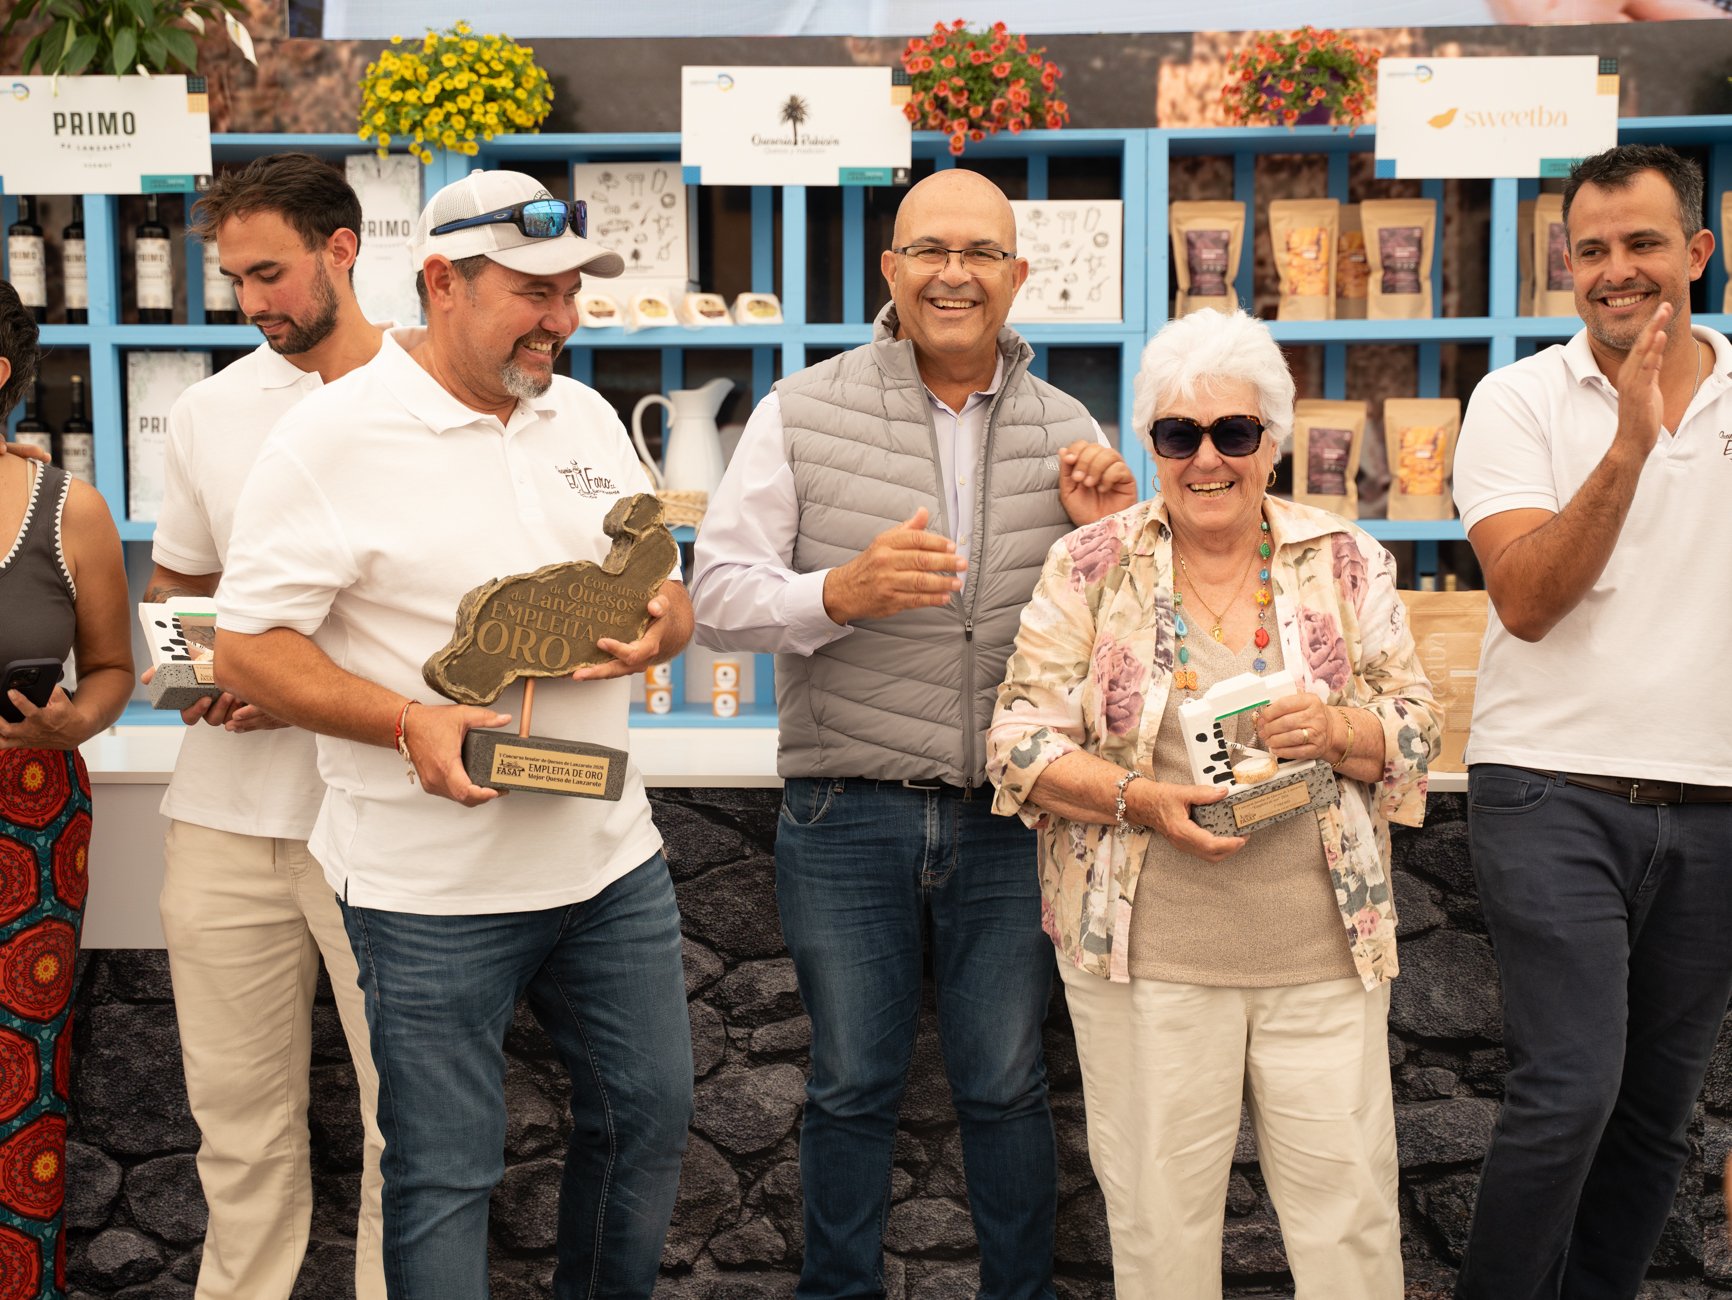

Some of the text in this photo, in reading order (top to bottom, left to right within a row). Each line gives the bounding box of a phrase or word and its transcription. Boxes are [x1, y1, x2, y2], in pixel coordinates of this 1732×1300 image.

[53, 112, 136, 136] PRIMO
[1464, 105, 1568, 128] sweetba
[139, 416, 168, 434] PRI
[551, 582, 638, 612] de Quesos
[583, 575, 649, 600] Concurso
[511, 587, 628, 627] de Lanzarote
[490, 600, 595, 642] EMPLEITA
[477, 619, 571, 669] ORO
[496, 766, 523, 777] FASAT
[528, 763, 603, 781] EMPLEITA DE ORO
[528, 773, 545, 781] Mejor
[572, 778, 602, 788] Lanzarote
